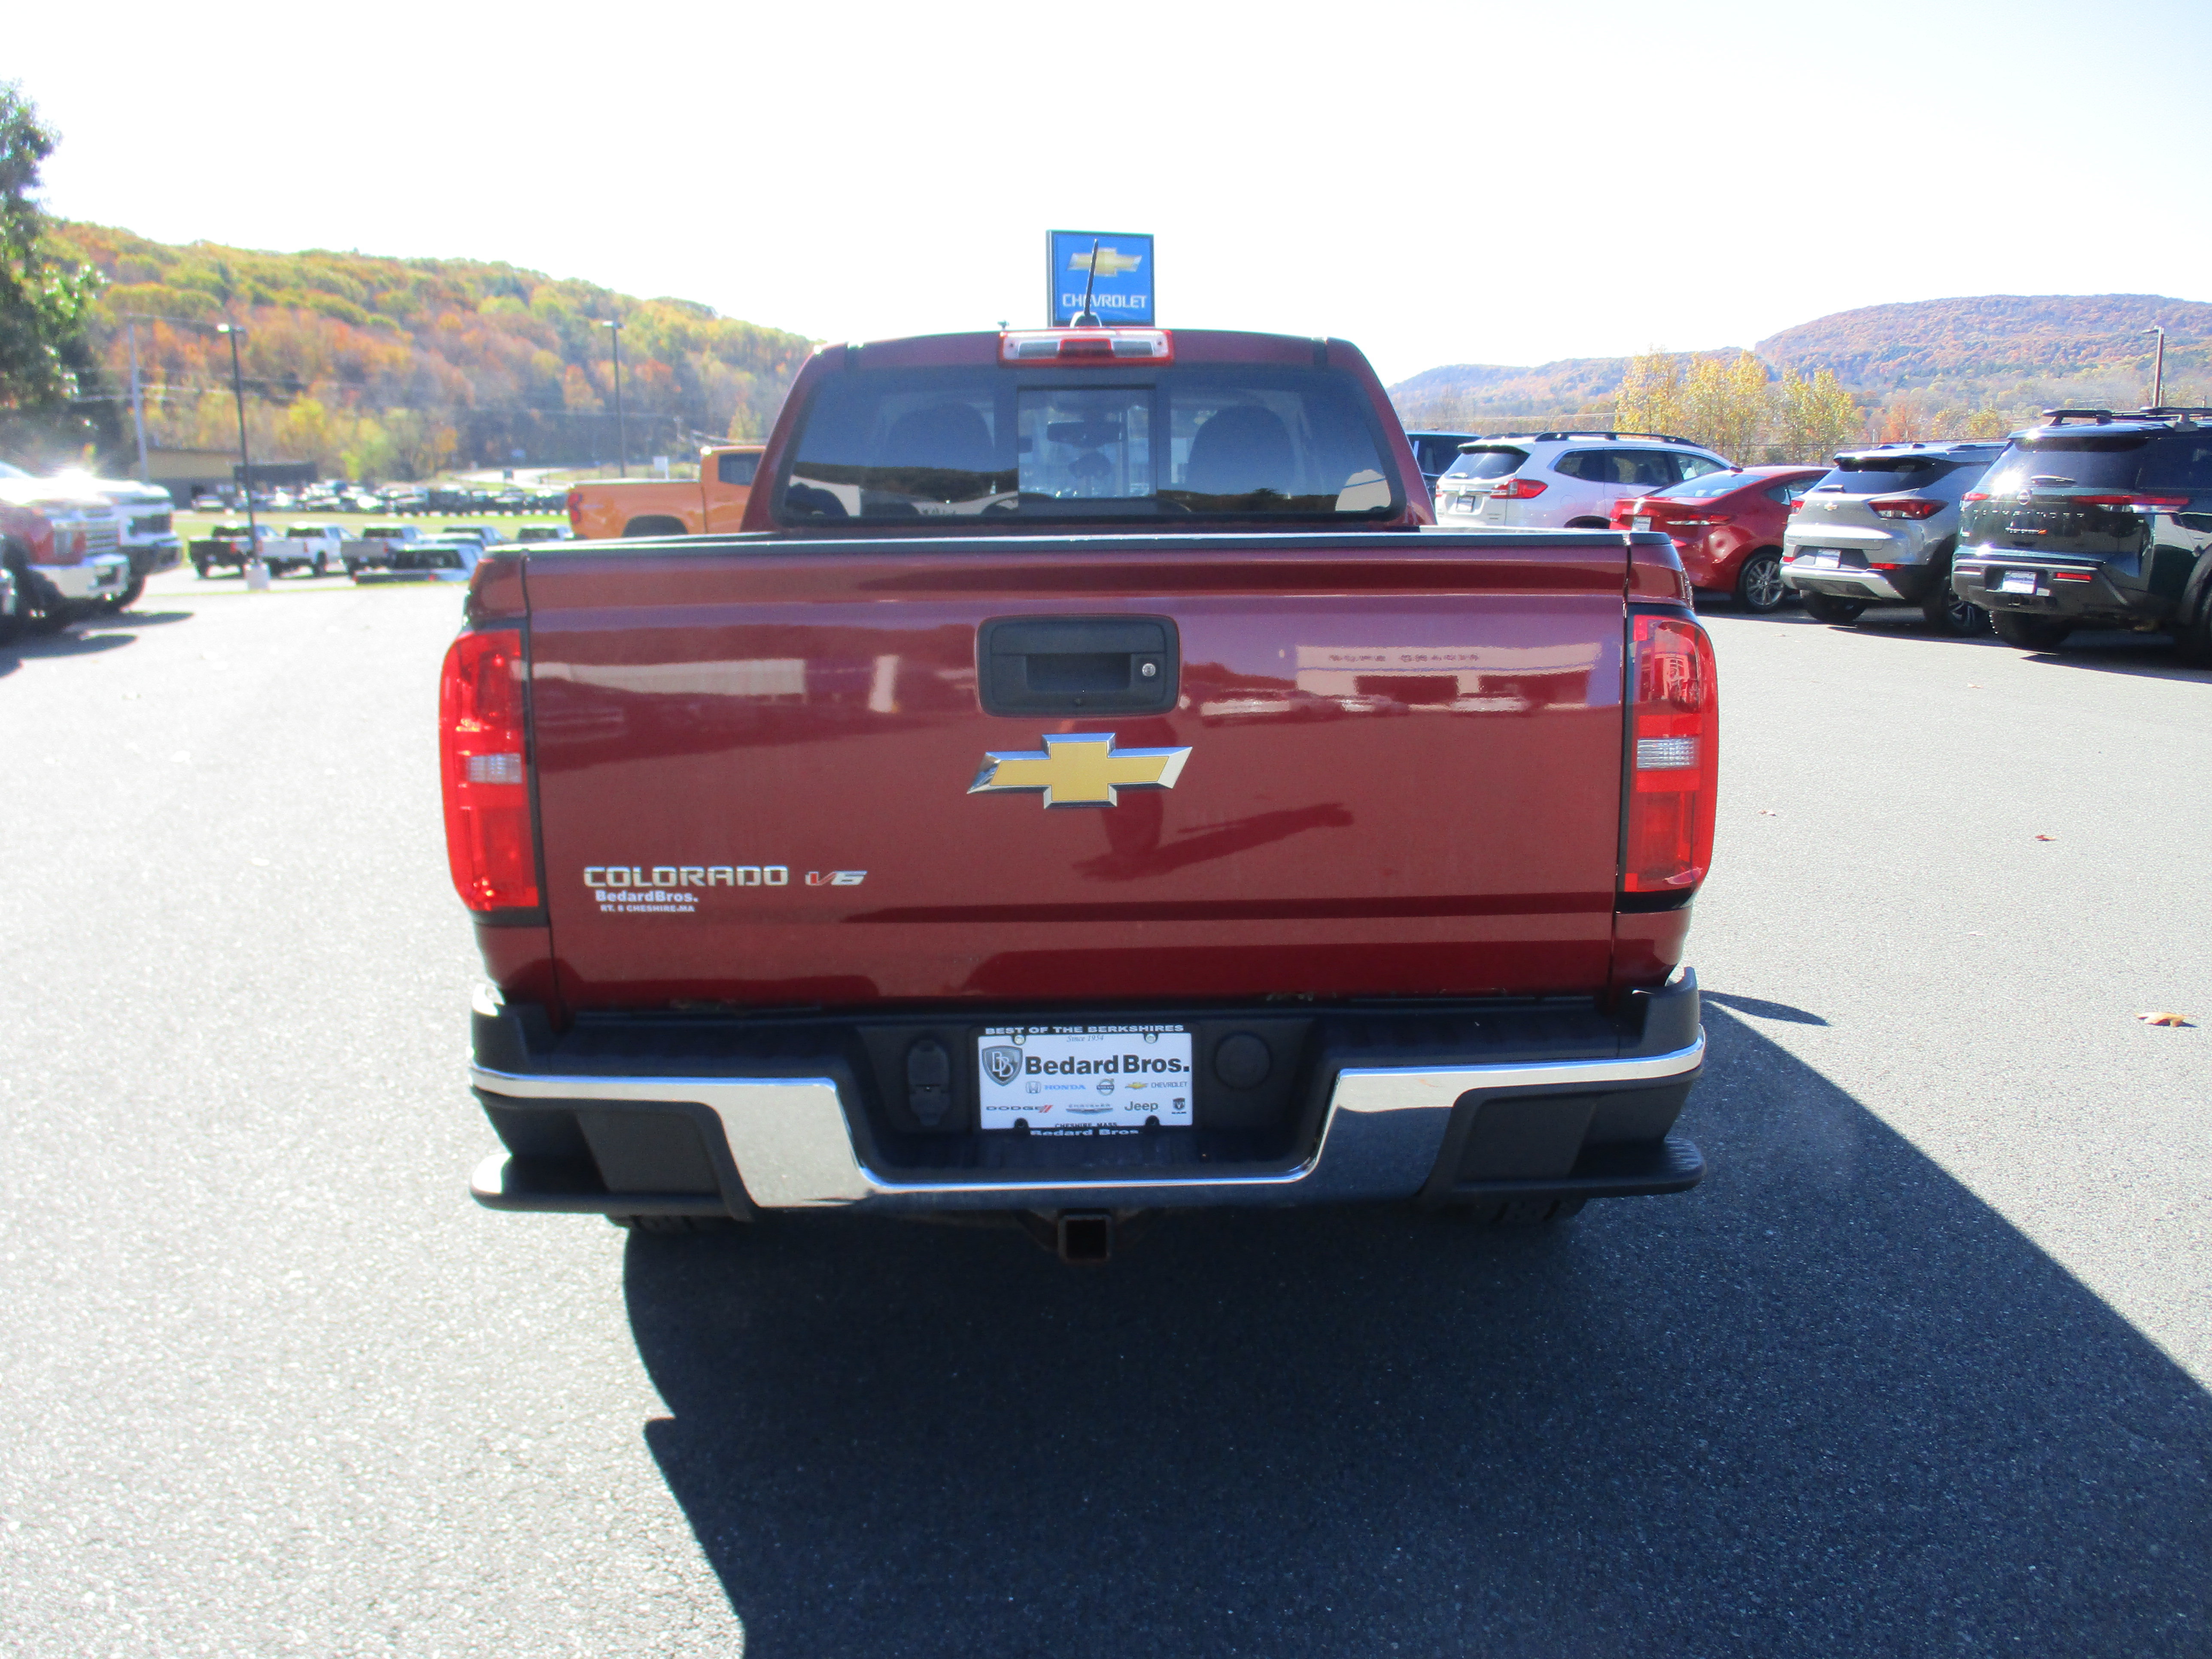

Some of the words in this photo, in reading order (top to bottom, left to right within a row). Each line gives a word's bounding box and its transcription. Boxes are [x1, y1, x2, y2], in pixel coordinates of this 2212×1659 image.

[583, 865, 788, 887] COLORADO
[805, 871, 867, 886] V6
[1025, 1055, 1118, 1074] Bedard
[1123, 1054, 1190, 1073] Bros.
[1124, 1101, 1158, 1112] Jeep
